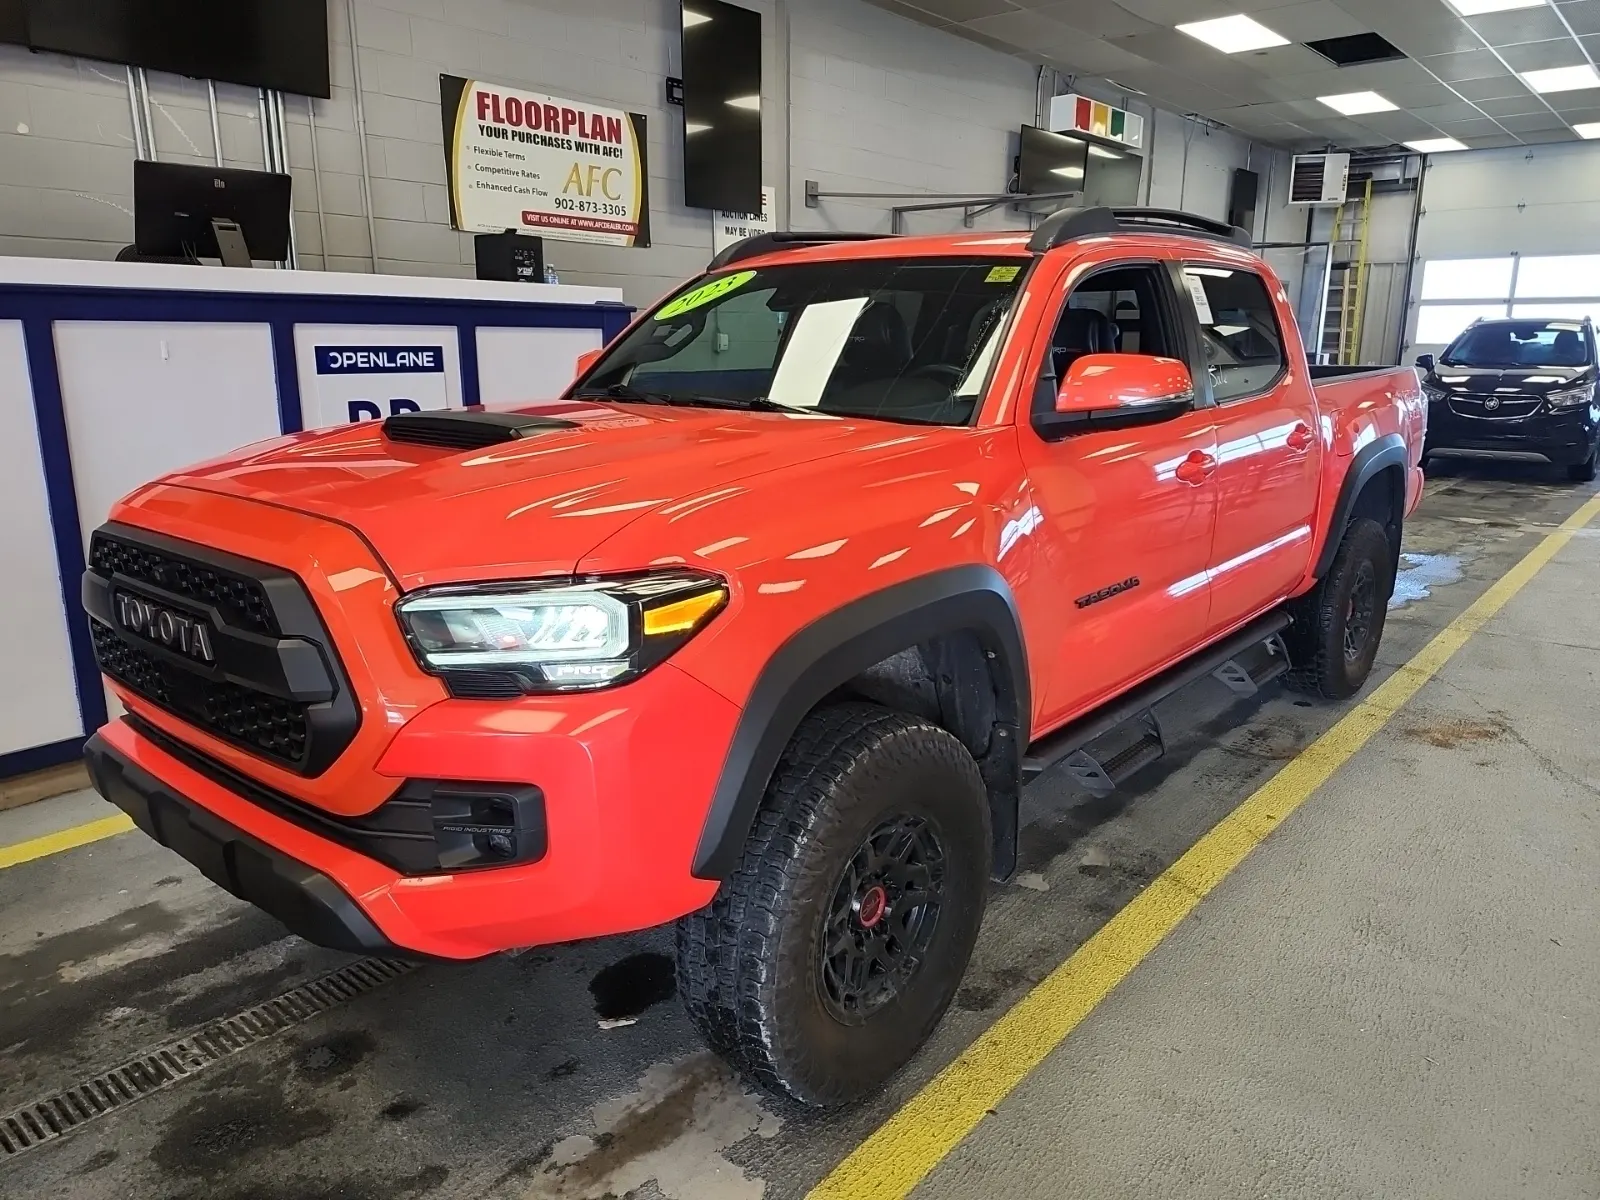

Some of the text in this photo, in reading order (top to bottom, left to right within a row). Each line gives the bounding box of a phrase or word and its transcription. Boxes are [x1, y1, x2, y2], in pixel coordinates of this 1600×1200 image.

[476, 91, 622, 144] FLOORPLAN
[478, 124, 623, 159] YOUR PURCHASES WITH AFC!
[473, 146, 526, 161] Flexible Terms
[474, 163, 541, 180] Competitive Rates
[476, 181, 549, 197] Enhanced Cash Flow
[562, 162, 623, 201] AFC
[554, 197, 627, 217] 902-873-3305
[721, 210, 748, 221] AUCTION
[526, 213, 634, 232] VISIT US ONLINE AT WWW.AFCDEALER.COM
[724, 225, 738, 236] MAY
[739, 227, 747, 237] BE
[328, 351, 435, 368] OPENLANE
[116, 592, 214, 661] TOYOTA
